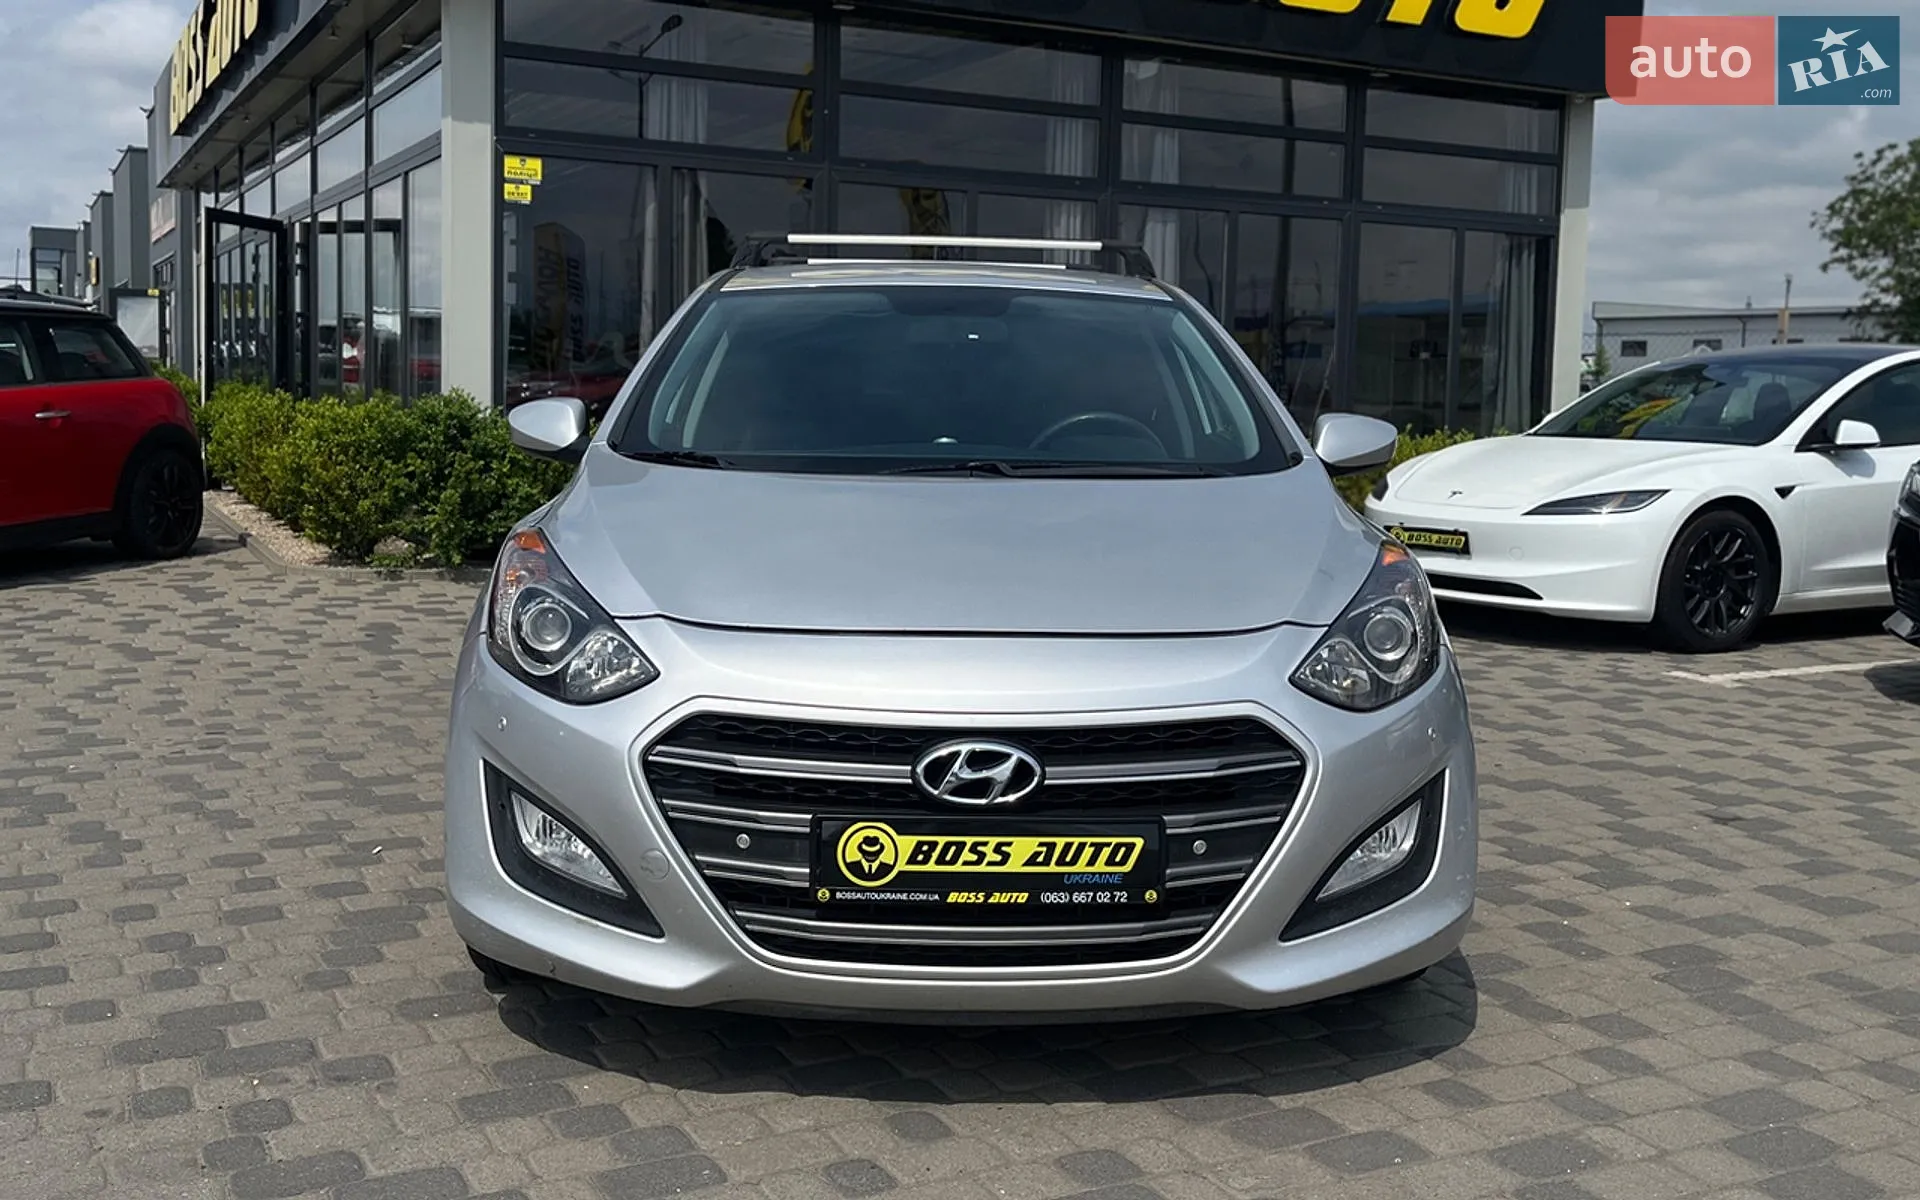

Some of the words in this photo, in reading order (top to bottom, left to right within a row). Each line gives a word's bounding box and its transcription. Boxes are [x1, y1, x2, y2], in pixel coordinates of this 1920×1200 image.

[1407, 533, 1433, 543] BOSS
[1435, 535, 1463, 546] AUTO
[905, 840, 1015, 866] BOSS
[1021, 841, 1137, 867] AUTO
[1063, 874, 1124, 884] UKRAINE
[835, 891, 940, 901] BOSSAUTOUKRAINE.COM.UA
[946, 892, 985, 903] BOSS
[987, 892, 1029, 903] AUTO
[1040, 891, 1070, 903] (063)
[1072, 891, 1095, 903] 667
[1096, 891, 1111, 903] 02
[1113, 891, 1128, 903] 72
